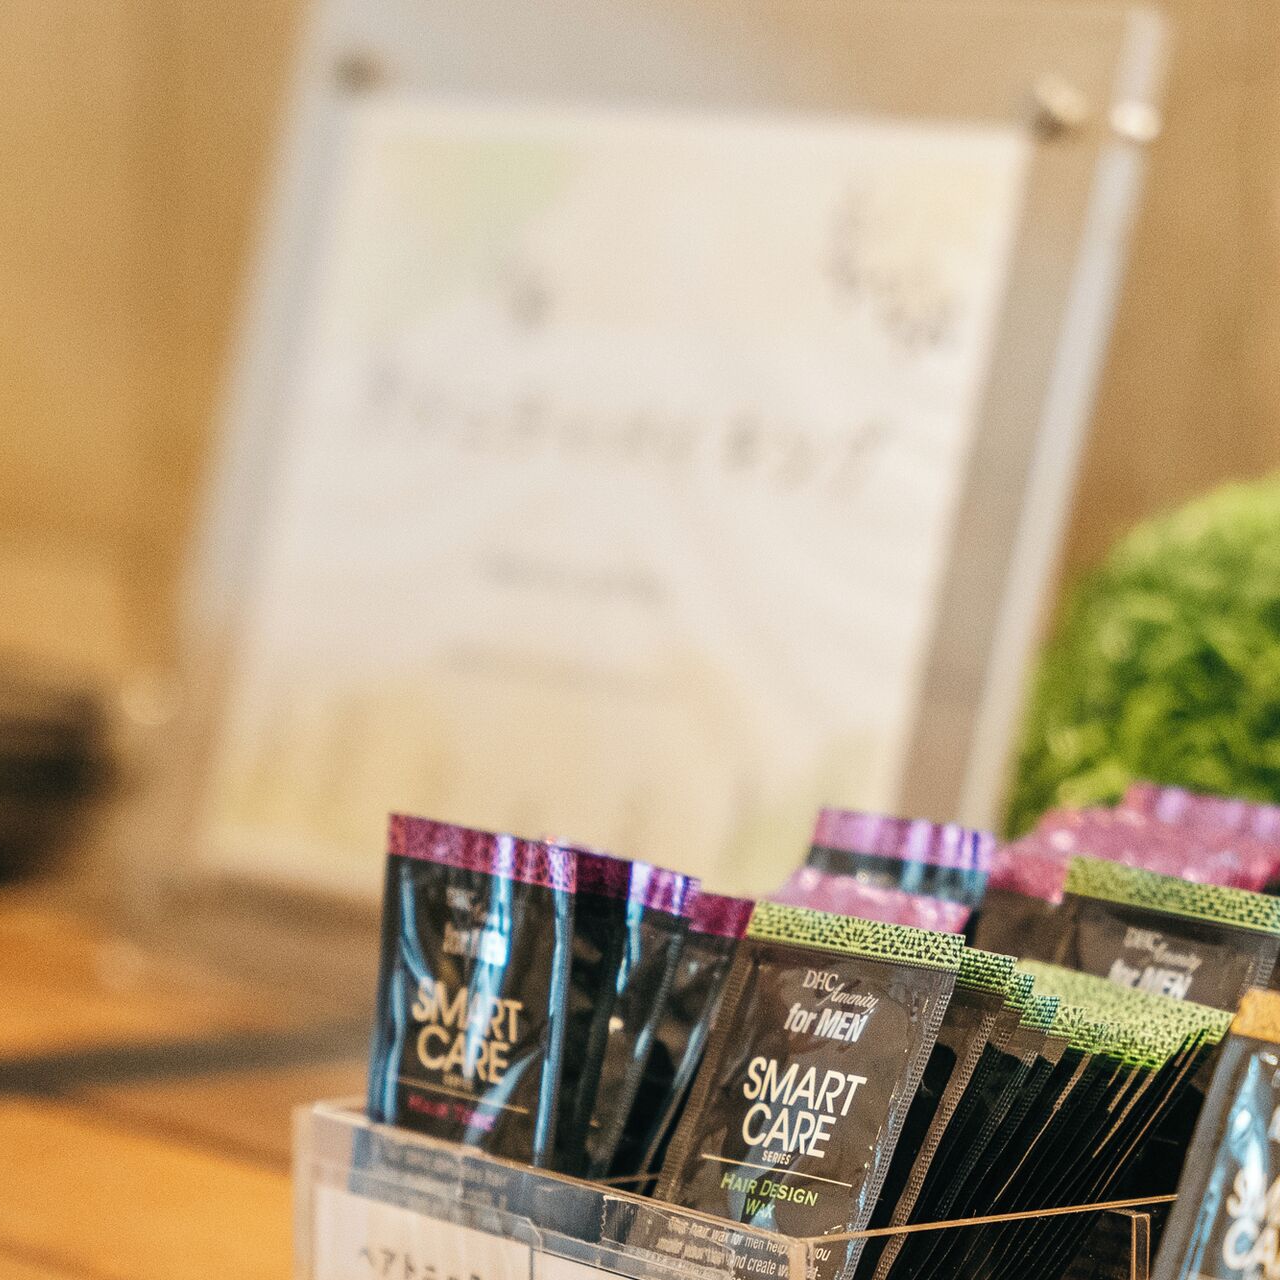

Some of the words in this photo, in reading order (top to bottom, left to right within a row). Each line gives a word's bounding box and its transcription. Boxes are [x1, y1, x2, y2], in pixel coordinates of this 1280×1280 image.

[803, 970, 838, 992] DHC
[411, 979, 524, 1044] SMART
[783, 1002, 816, 1033] for
[813, 1007, 876, 1043] MEN
[417, 1023, 511, 1085] CARE
[742, 1055, 868, 1117] SMART
[741, 1102, 837, 1159] CARE
[761, 1150, 791, 1166] SERIES
[720, 1172, 758, 1195] HAIR
[759, 1179, 819, 1207] DESIGN
[730, 1229, 744, 1245] for
[744, 1236, 766, 1250] men
[812, 1246, 832, 1262] ou
[747, 1254, 776, 1276] create
